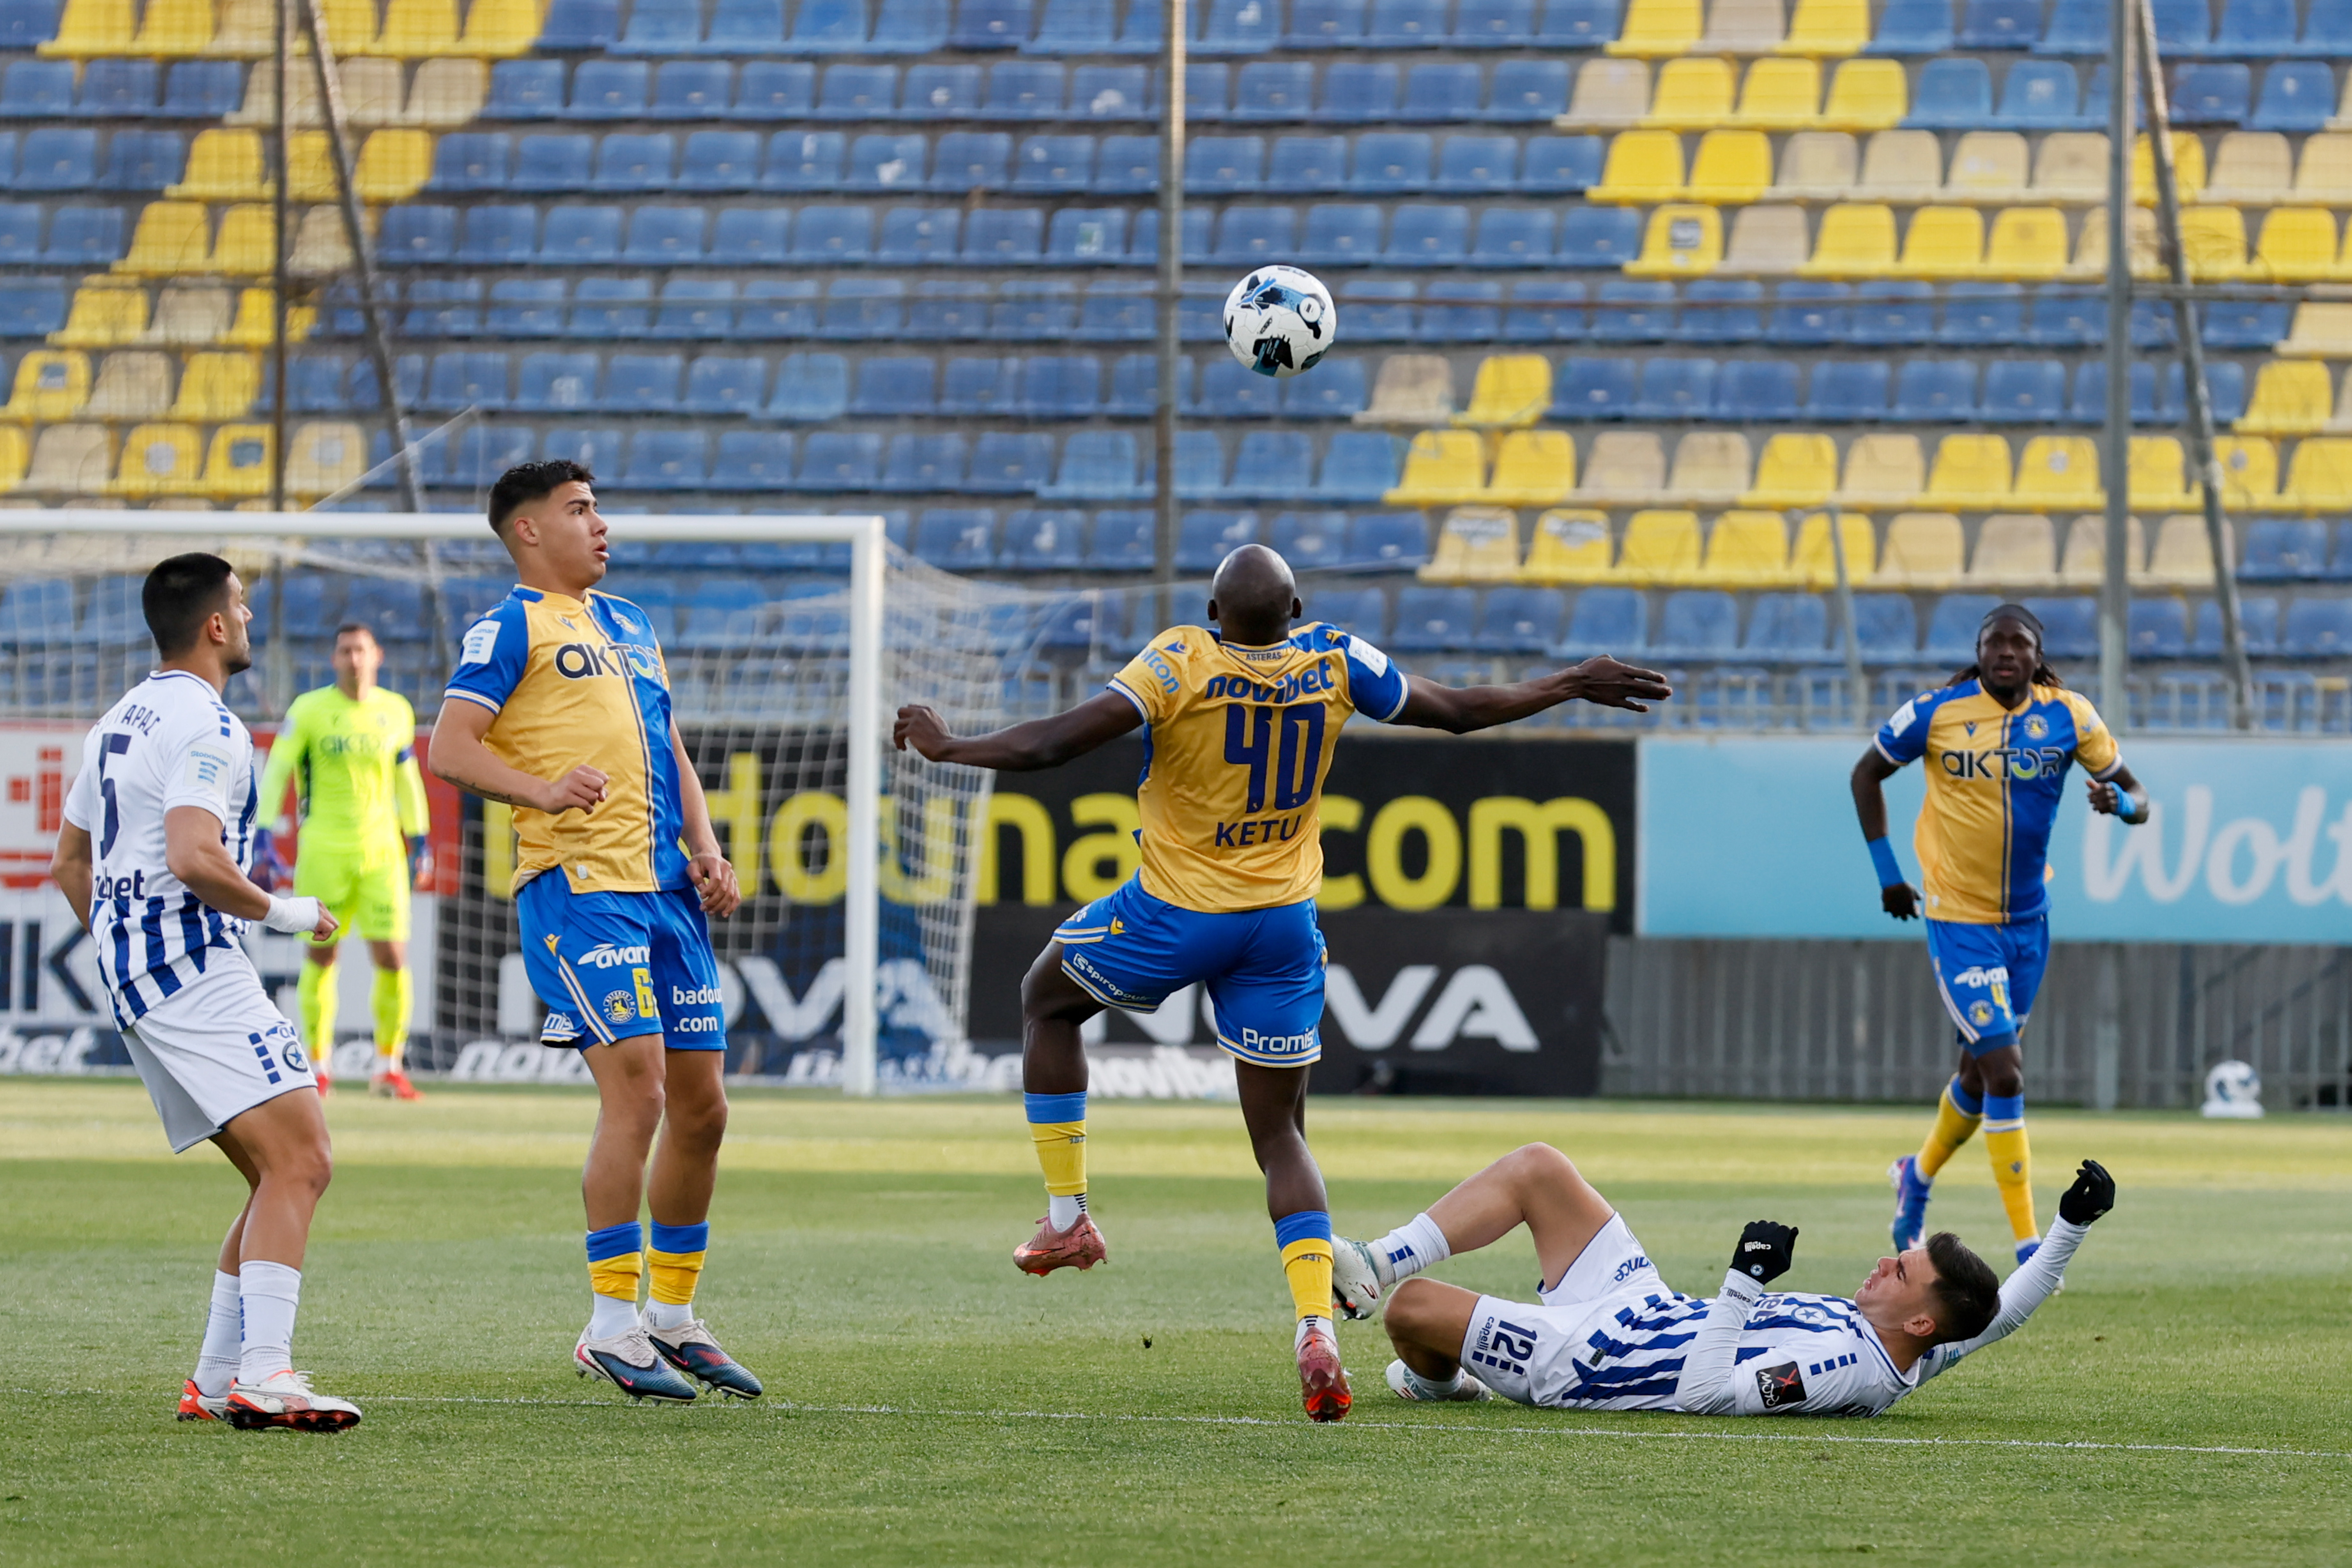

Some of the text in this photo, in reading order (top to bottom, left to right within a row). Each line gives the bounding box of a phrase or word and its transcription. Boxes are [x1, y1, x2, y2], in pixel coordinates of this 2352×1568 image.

[1245, 652, 1282, 661] ASTERAS
[1204, 658, 1335, 704] novibet
[1224, 702, 1325, 814] 40
[99, 732, 132, 860] 5
[1215, 815, 1301, 847] KETU
[674, 1016, 718, 1032] .com
[1478, 1317, 1495, 1351] capelli
[1491, 1320, 1537, 1361] 12
